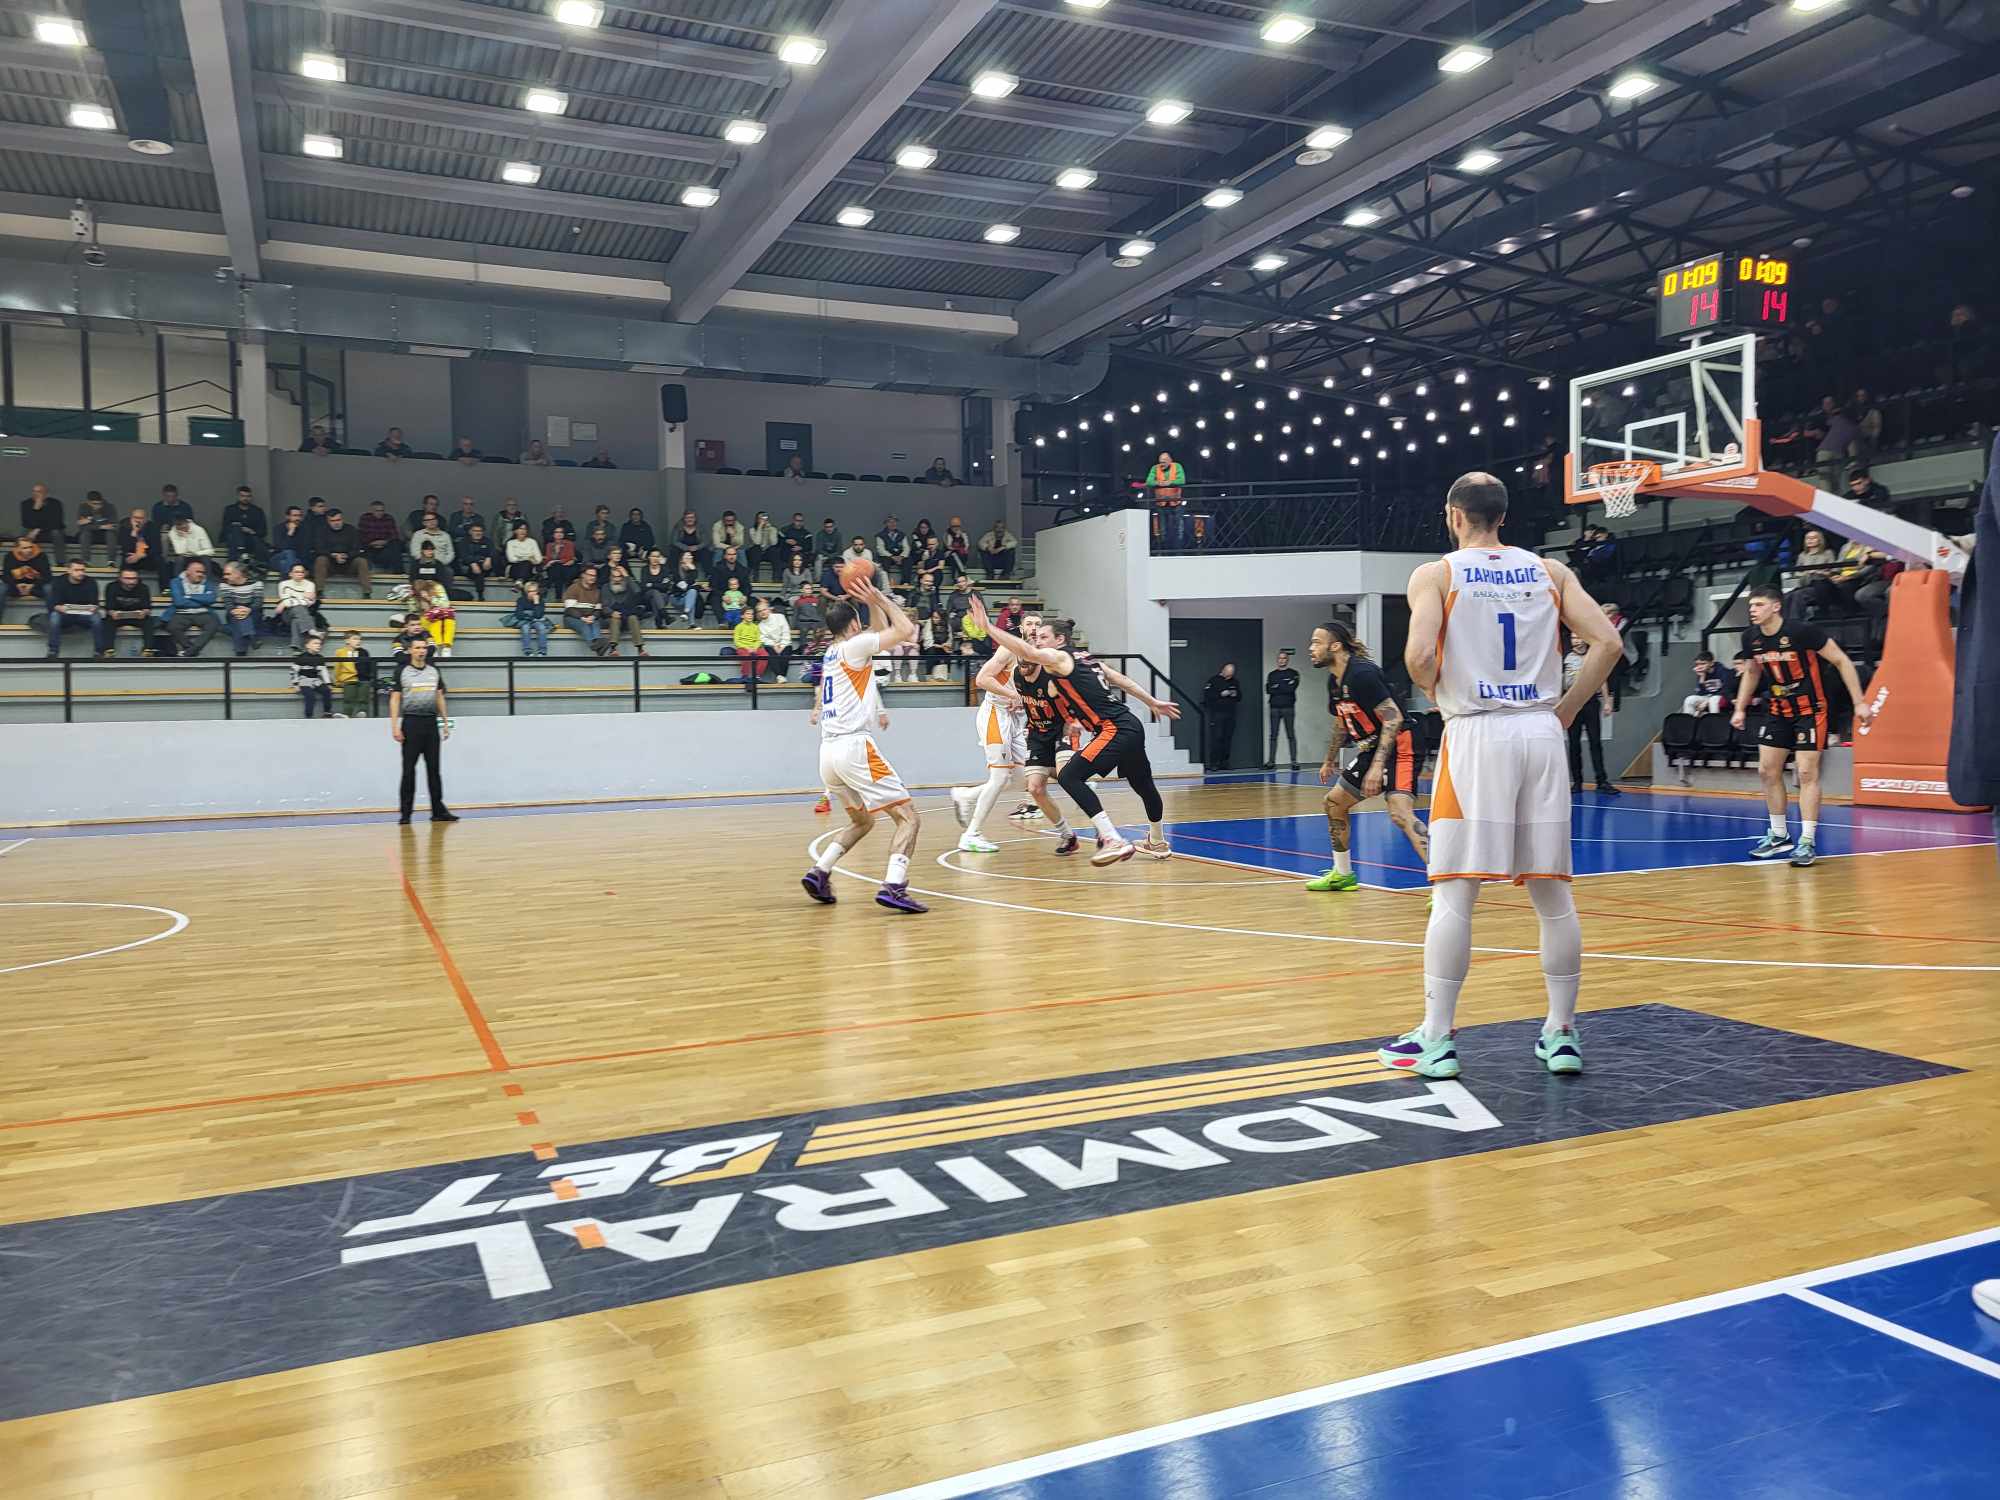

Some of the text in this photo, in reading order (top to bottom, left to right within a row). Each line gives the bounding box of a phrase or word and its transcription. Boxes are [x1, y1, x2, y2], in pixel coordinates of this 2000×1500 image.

[1690, 288, 1719, 328] 14
[1762, 290, 1788, 322] 14
[1497, 613, 1516, 670] 1
[341, 1080, 1504, 1300] ADMIRAL
[342, 1131, 784, 1237] BET
